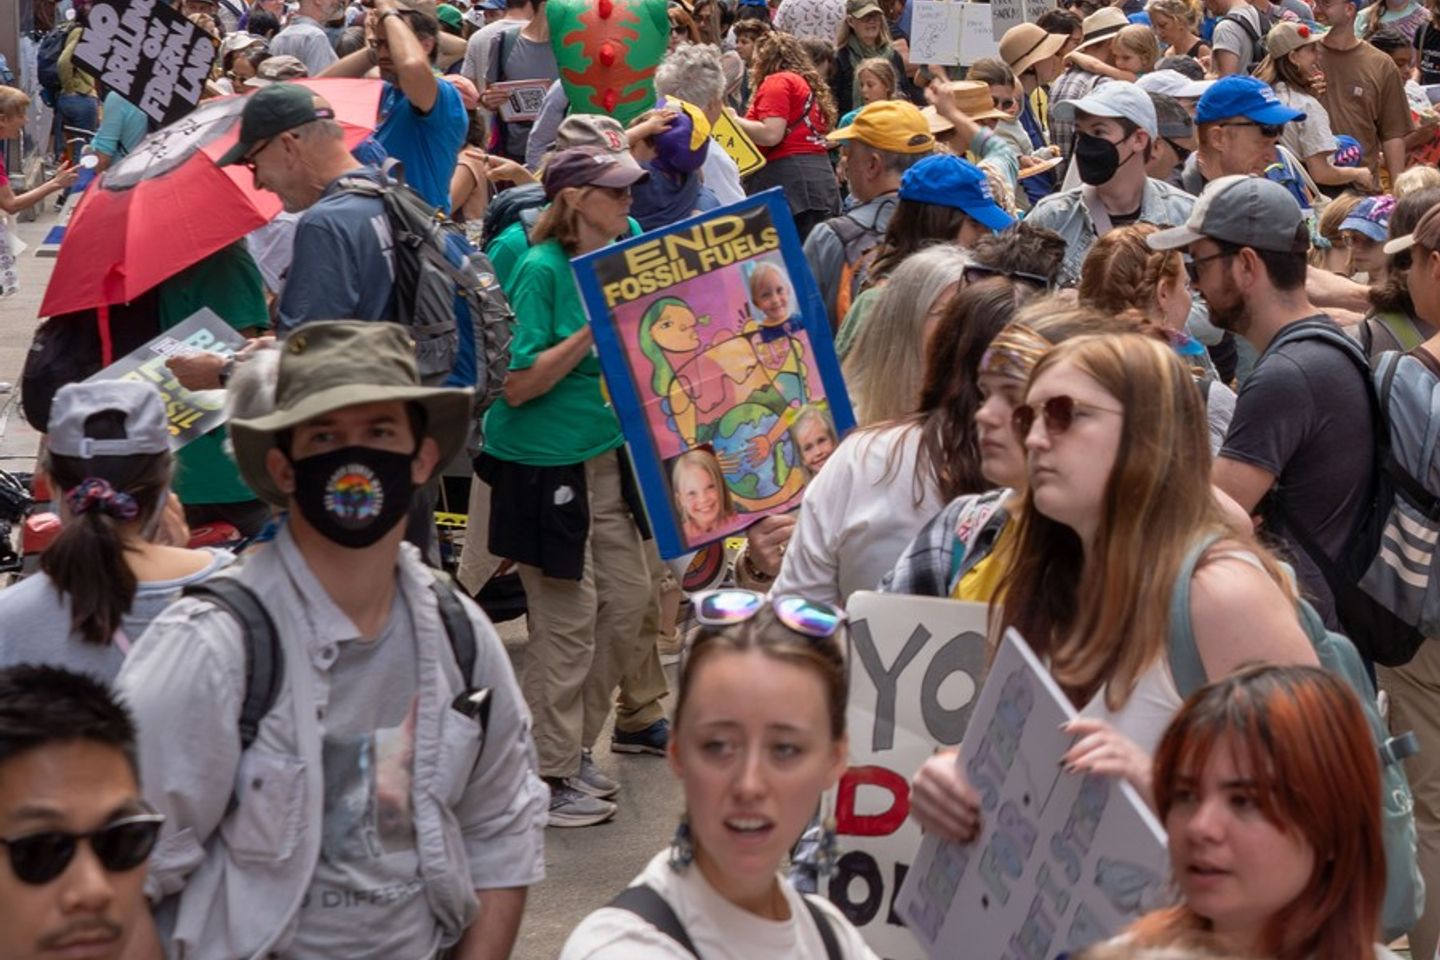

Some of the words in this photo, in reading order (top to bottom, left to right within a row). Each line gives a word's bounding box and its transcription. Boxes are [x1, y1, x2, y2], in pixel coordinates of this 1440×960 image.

[73, 3, 120, 72] NO
[142, 17, 170, 59] ON
[174, 36, 216, 106] LAND
[602, 259, 698, 307] FOSSIL
[698, 227, 780, 272] FUELS
[624, 215, 745, 275] END
[850, 616, 992, 753] YO
